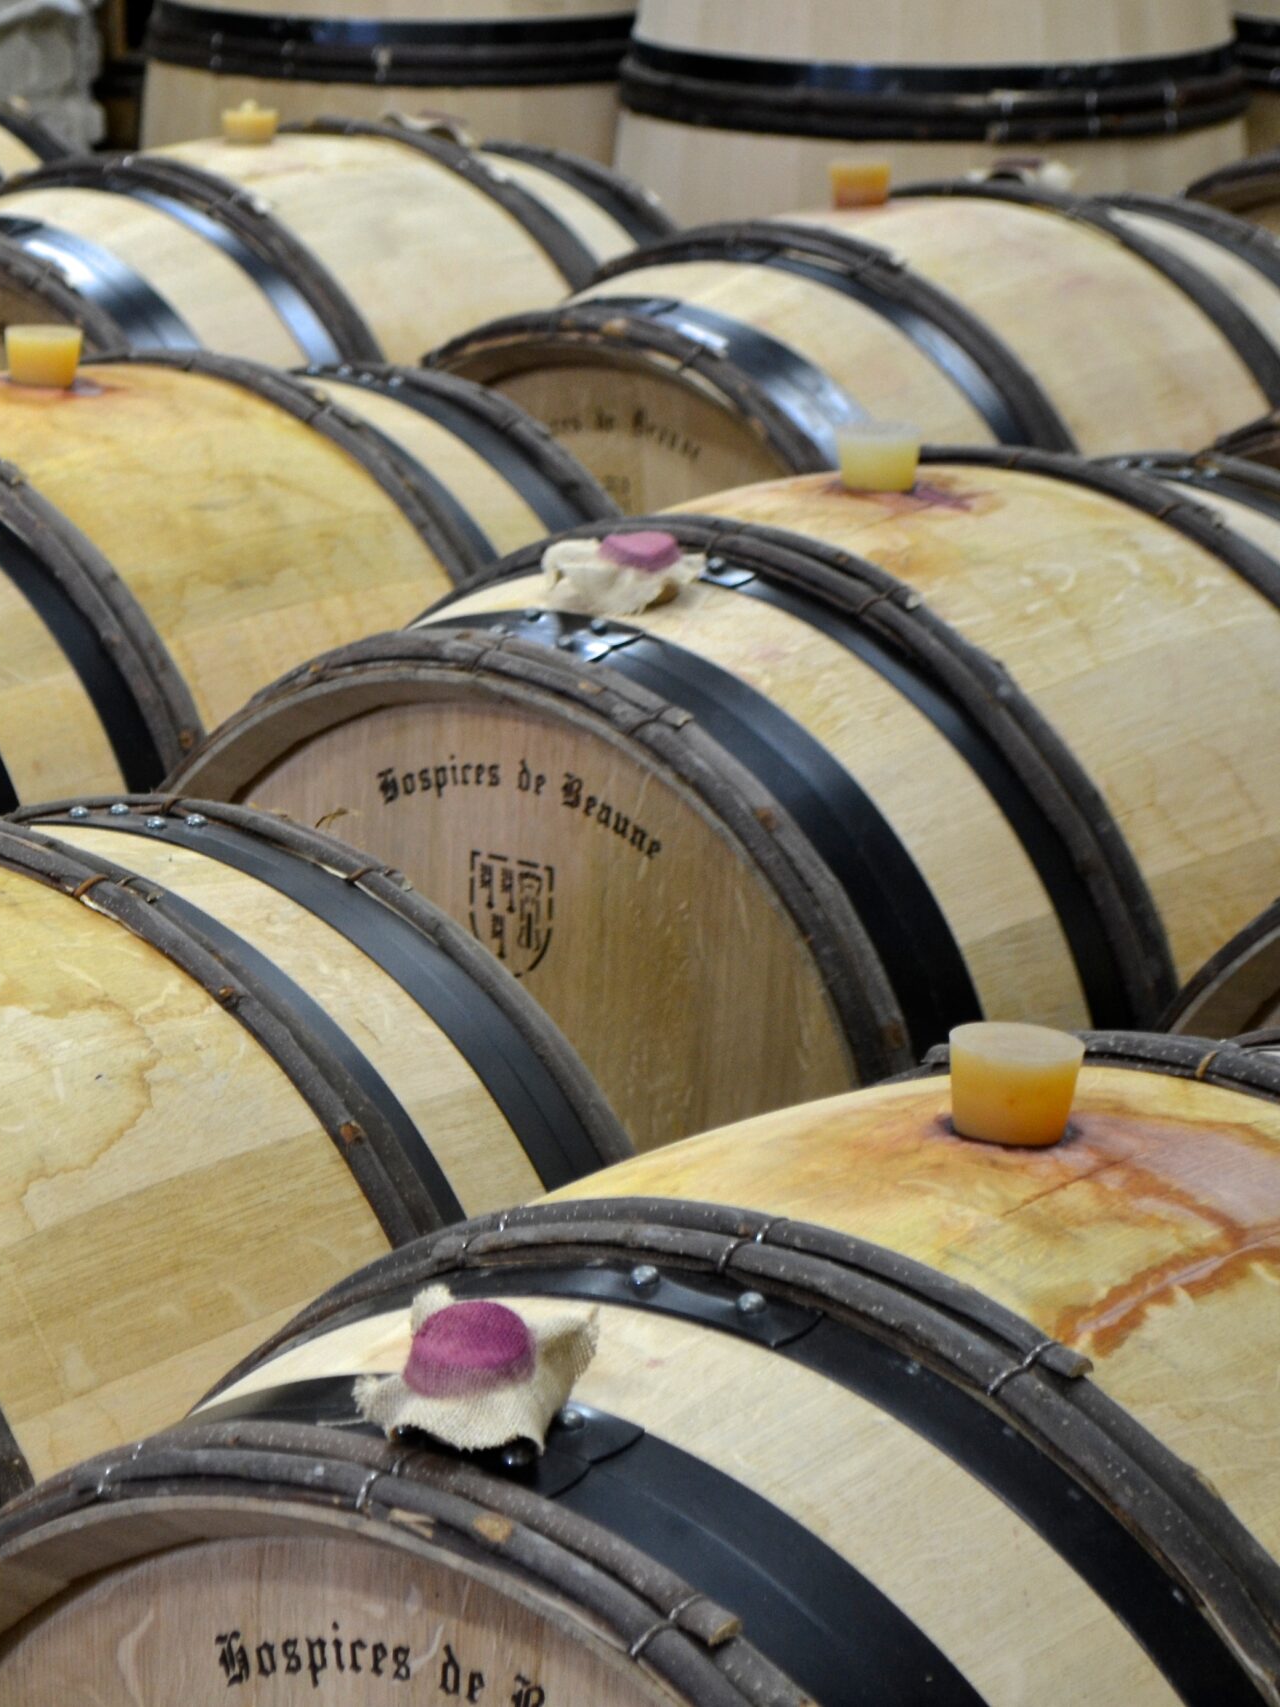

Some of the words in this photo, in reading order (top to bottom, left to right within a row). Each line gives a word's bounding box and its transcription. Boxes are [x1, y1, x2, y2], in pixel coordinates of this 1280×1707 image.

[377, 754, 501, 805] Hospices
[516, 758, 546, 796] de
[561, 772, 663, 860] Beaune
[215, 1621, 412, 1688] Hospices
[438, 1644, 486, 1705] de
